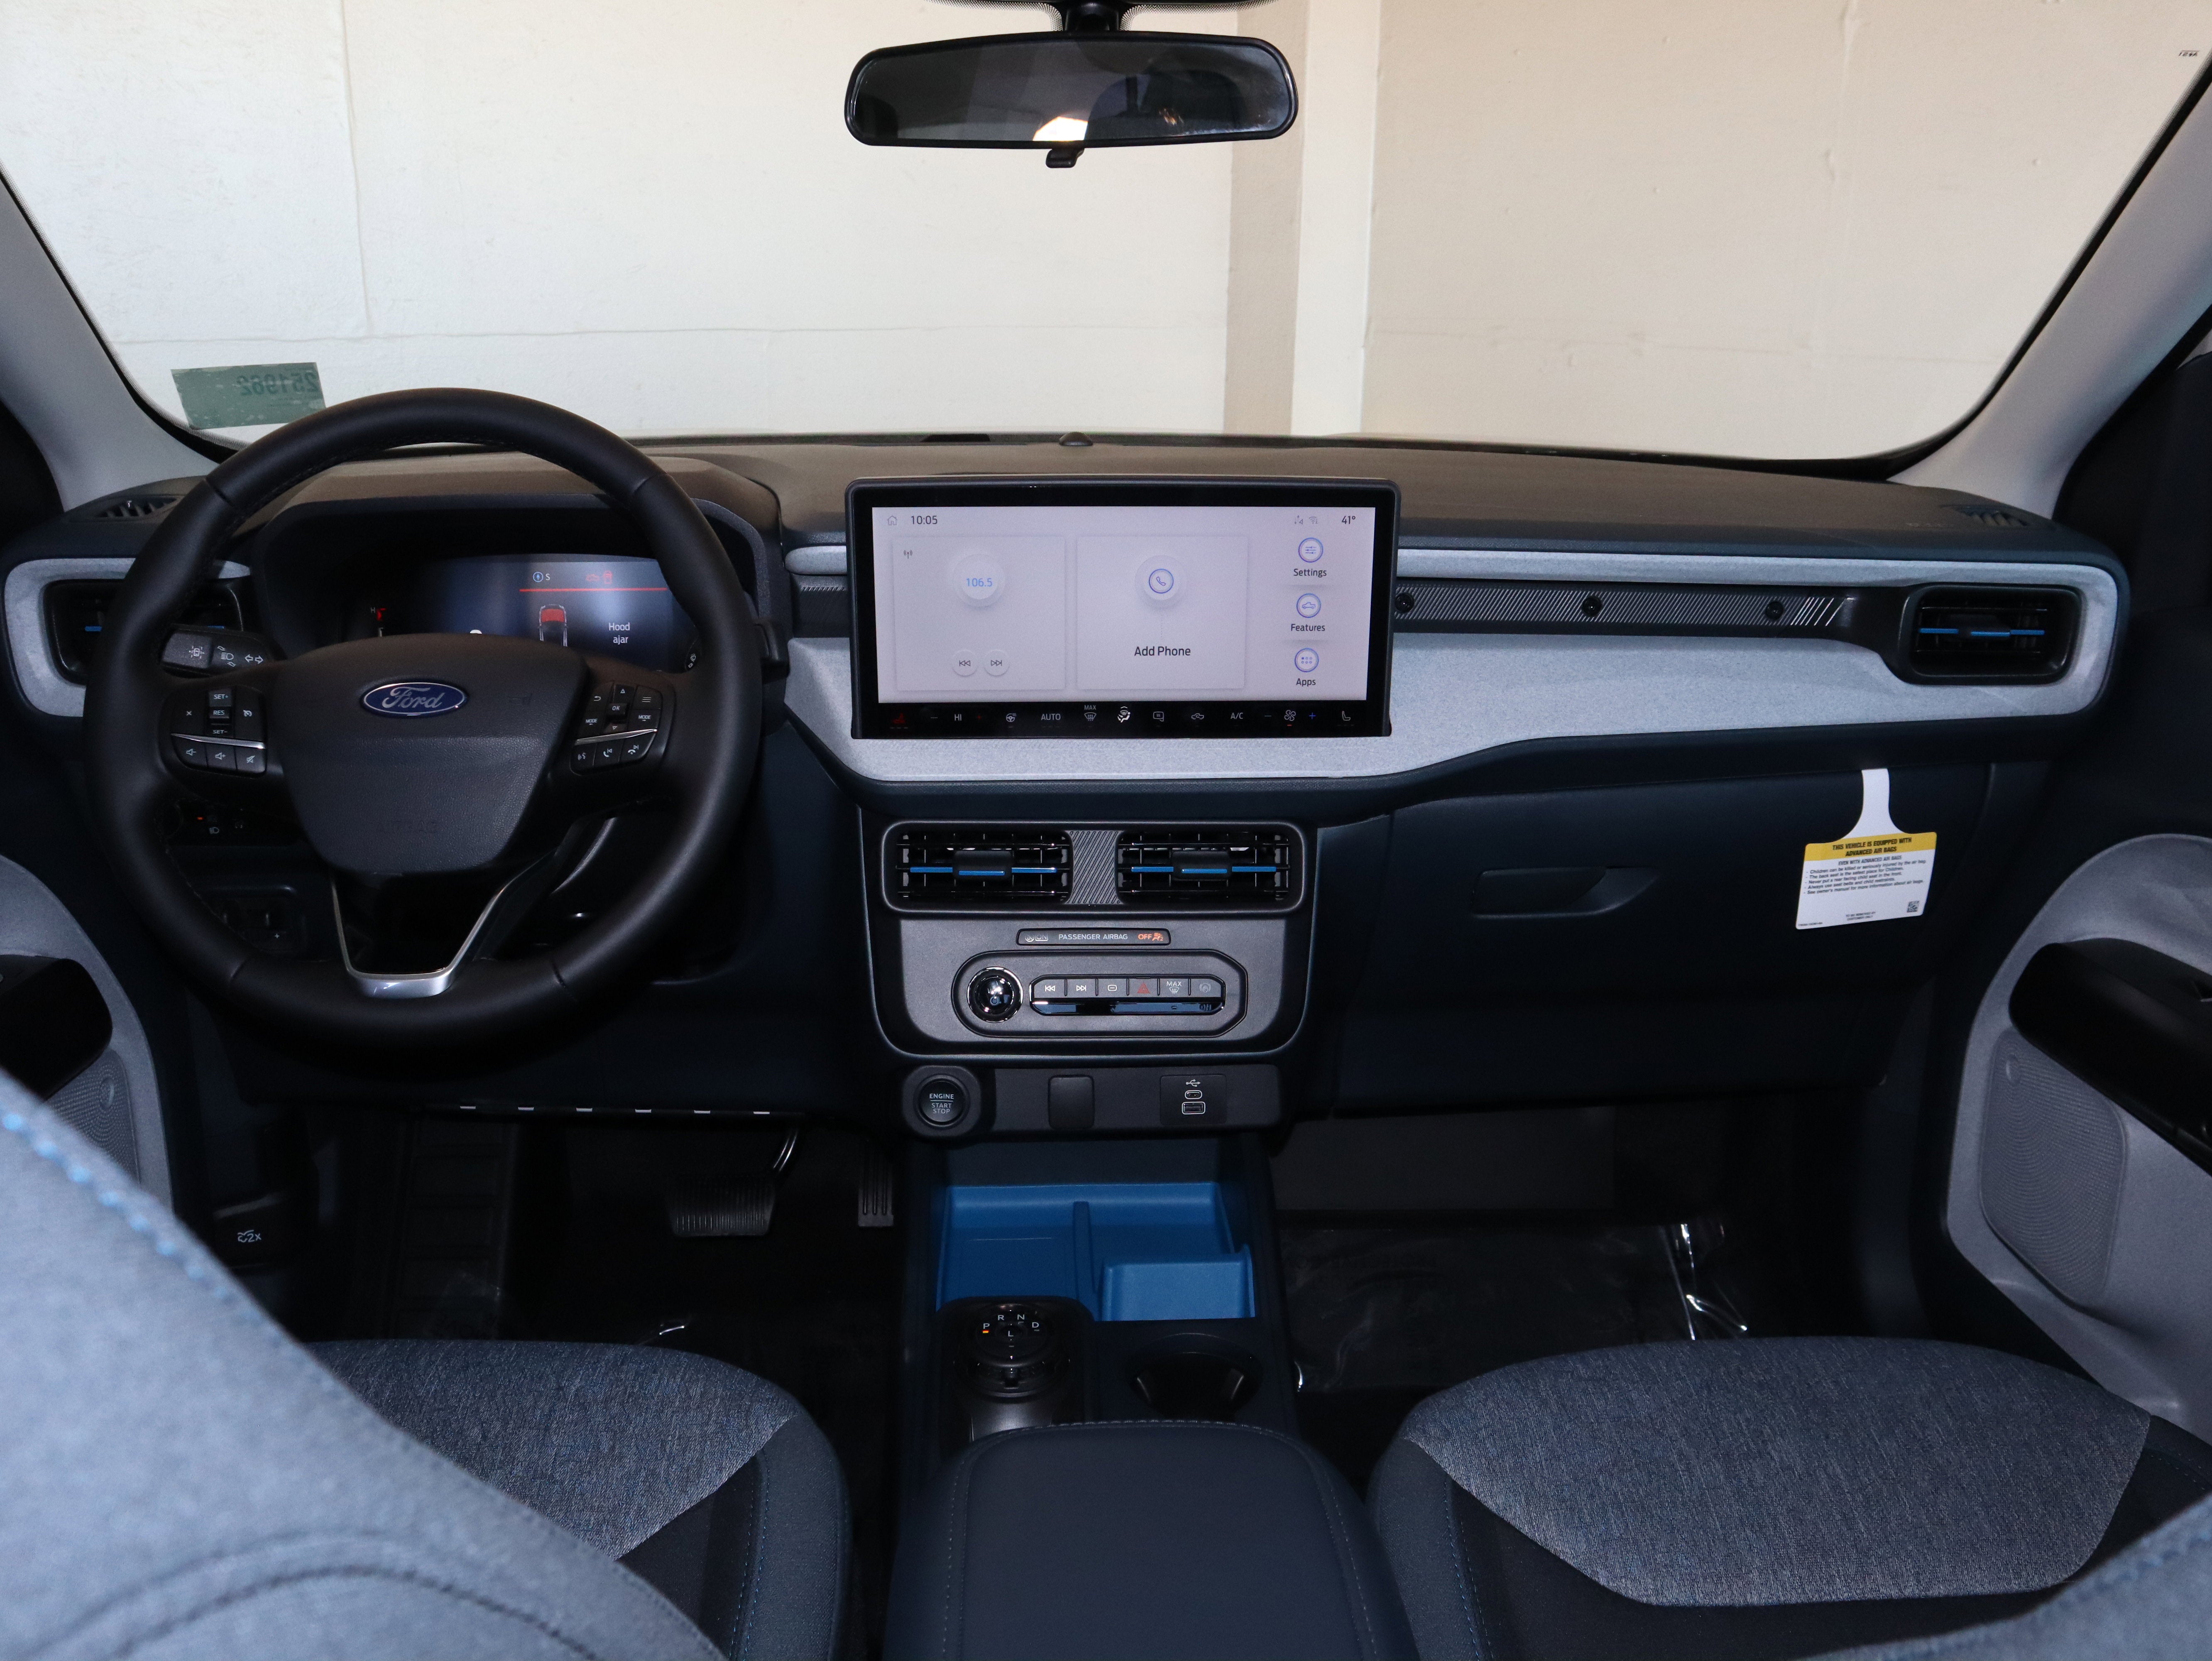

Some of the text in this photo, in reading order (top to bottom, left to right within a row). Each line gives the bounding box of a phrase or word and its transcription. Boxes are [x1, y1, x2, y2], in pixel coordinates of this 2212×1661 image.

[911, 515, 938, 524] 10:05
[1341, 515, 1356, 524] 41°
[1293, 568, 1327, 578] Settings
[967, 578, 993, 587] 106.5
[608, 622, 630, 632] Hood
[1290, 623, 1326, 632] Features
[613, 635, 629, 645] ajar
[1134, 645, 1191, 656] Add Phone
[1295, 677, 1316, 687] Apps
[382, 686, 445, 709] Ford
